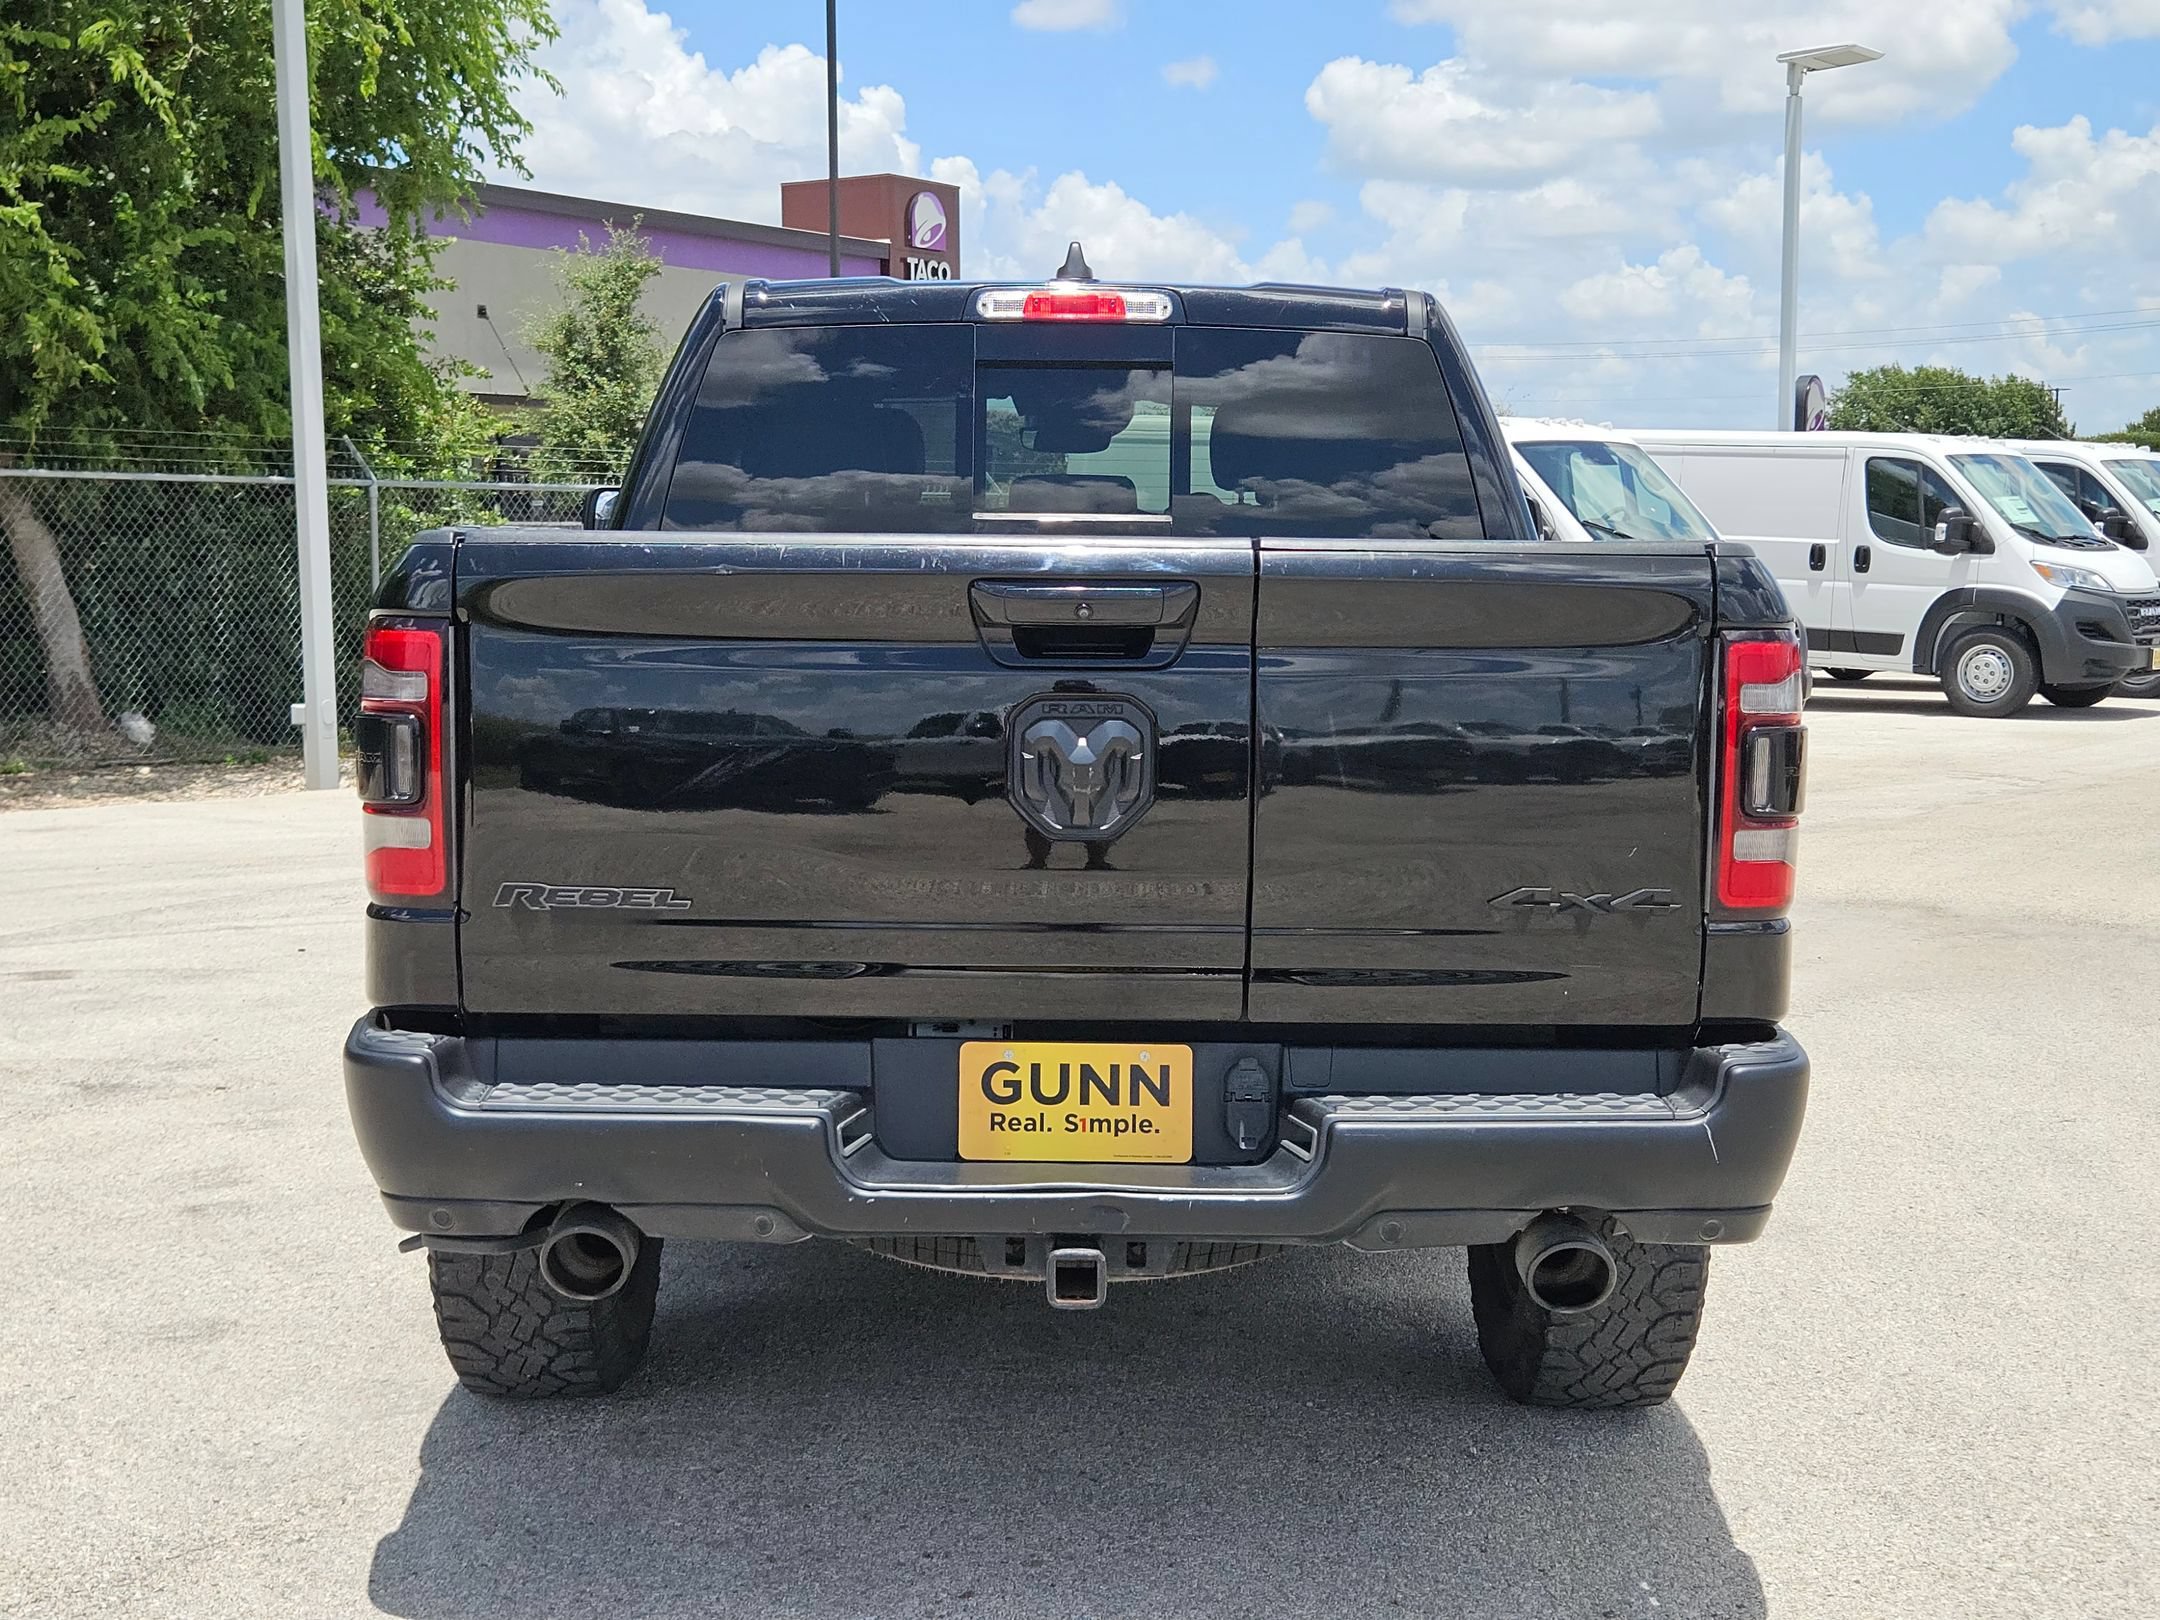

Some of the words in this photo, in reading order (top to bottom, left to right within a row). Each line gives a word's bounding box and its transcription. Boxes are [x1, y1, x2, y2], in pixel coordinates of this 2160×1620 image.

[907, 257, 951, 281] TACO
[1041, 703, 1124, 715] RAM
[492, 881, 693, 910] REBEL
[981, 1061, 1171, 1107] GUNN
[990, 1112, 1052, 1133] Real.
